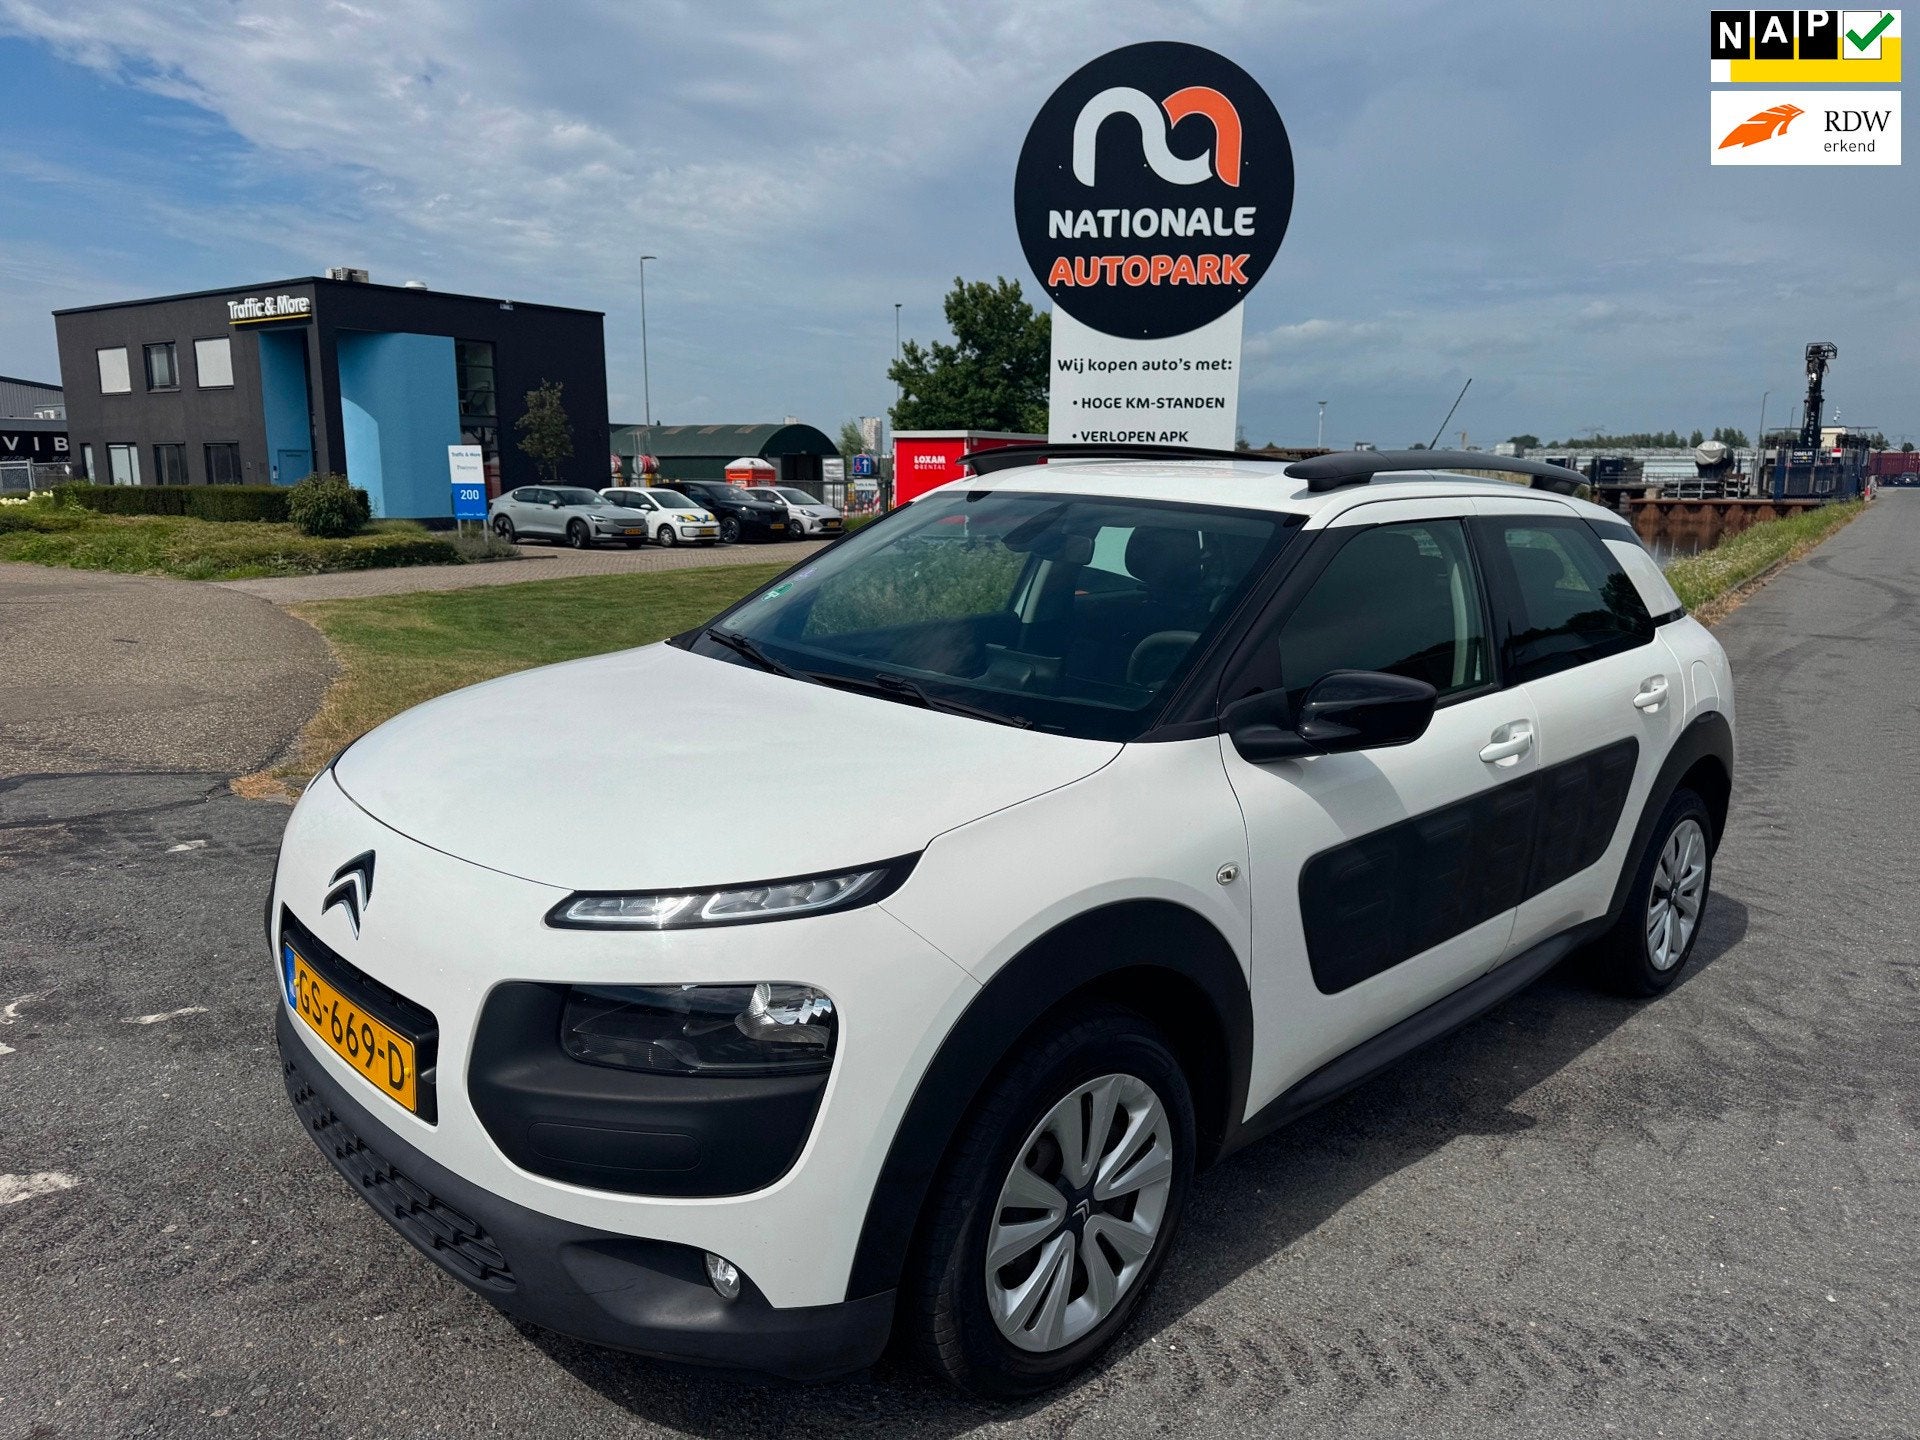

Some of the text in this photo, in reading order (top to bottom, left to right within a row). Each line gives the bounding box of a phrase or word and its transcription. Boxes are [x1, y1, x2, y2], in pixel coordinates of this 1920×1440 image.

[1048, 206, 1257, 239] NATIONALE
[1048, 253, 1251, 287] AUTOPARK
[227, 295, 310, 319] Traffic & More
[1057, 358, 1232, 374] Wij kopen auto's met:
[1081, 397, 1225, 409] HOGE KM-STANDEN
[1081, 431, 1189, 443] VERLOPEN APK
[913, 455, 946, 464] LOXAM
[460, 489, 480, 500] 200
[299, 970, 405, 1091] GS-669-D
